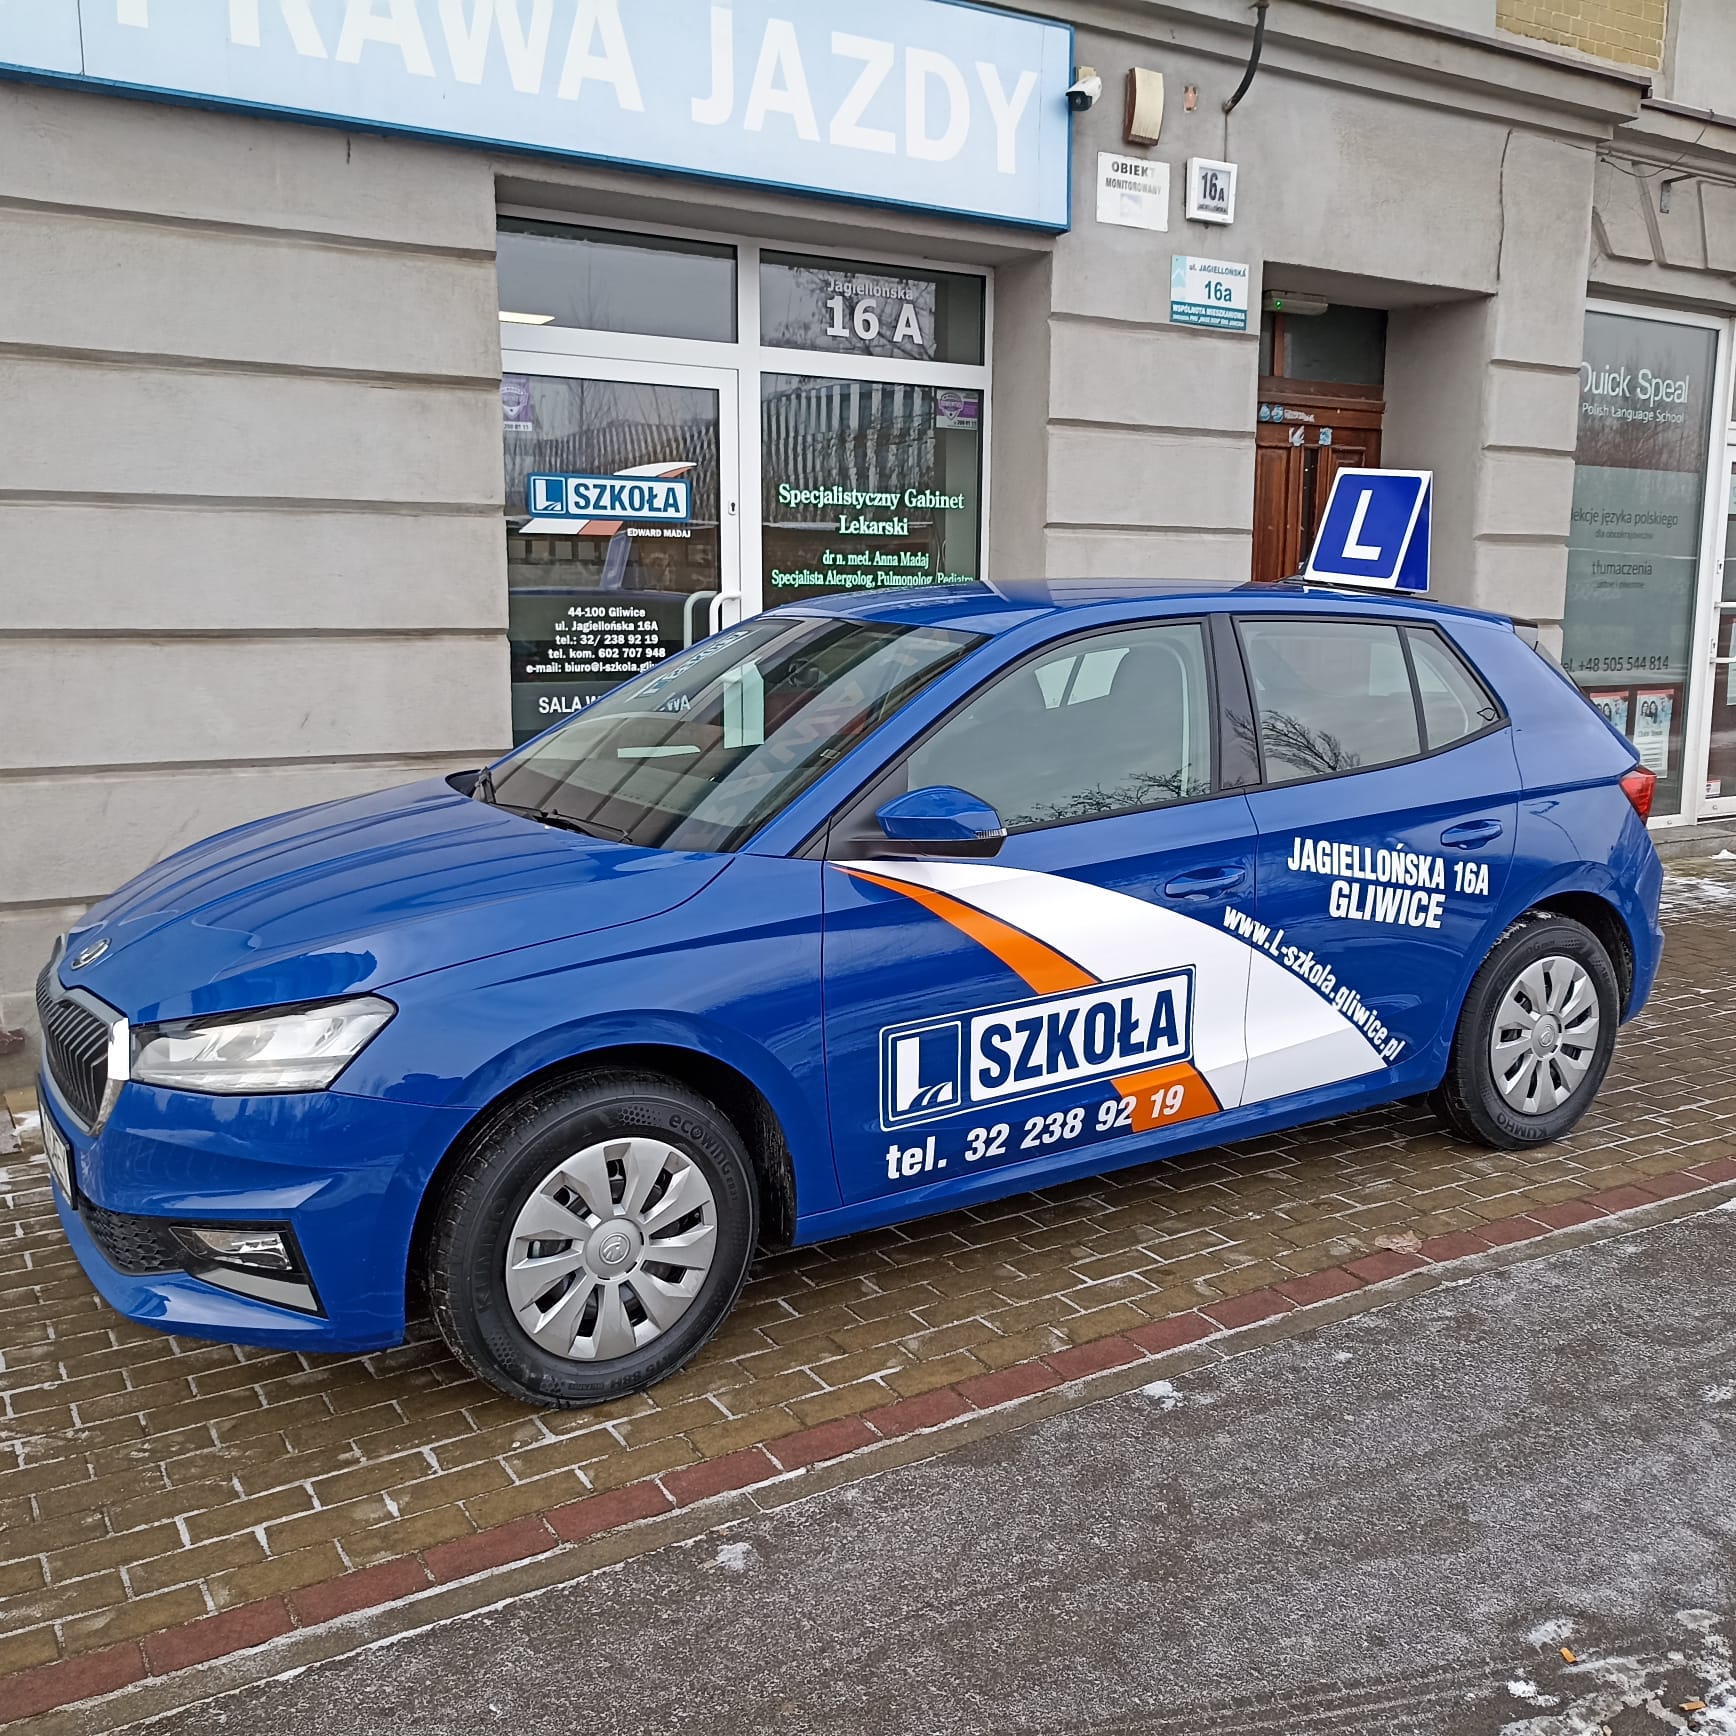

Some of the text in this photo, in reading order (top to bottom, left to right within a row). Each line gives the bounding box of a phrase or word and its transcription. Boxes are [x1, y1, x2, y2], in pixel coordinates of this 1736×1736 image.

[691, 4, 1038, 175] JAZDY
[1204, 280, 1232, 303] 16a
[1582, 402, 1684, 424] Polish Language School
[573, 483, 681, 514] SZKOŁA
[778, 483, 965, 510] Specjalistyczny Gabinet
[839, 514, 909, 536] Lekarski
[1341, 489, 1382, 561] L
[1634, 510, 1679, 528] polskiego
[627, 528, 692, 538] EDWARD MADAJ
[822, 550, 930, 569] dr n. med. Anna Madaj
[1592, 560, 1653, 576] tłumaczenia
[771, 569, 824, 587] Specjalista
[825, 569, 875, 587] Alergolog,
[568, 606, 646, 618] 44-100 Gliwice
[555, 620, 658, 633] ul. Jagiellońska 16A
[555, 635, 659, 647] tel.: 32/ 238 92 19
[548, 648, 666, 659] tel. kom. 602 707 948
[526, 662, 562, 673] e-mail:
[1578, 657, 1600, 673] +48
[1603, 656, 1624, 672] 505
[1626, 656, 1647, 671] 544
[1649, 655, 1669, 670] 814
[538, 696, 582, 713] SALA
[1287, 836, 1490, 896] JAGIELLOŃSKA 16A
[1328, 880, 1447, 929] GLIWICE
[1222, 905, 1406, 1062] www.L-szkola.gliwice.pl
[978, 988, 1180, 1089] SZKOŁA
[886, 1084, 1185, 1180] tel. 32 238 92 19
